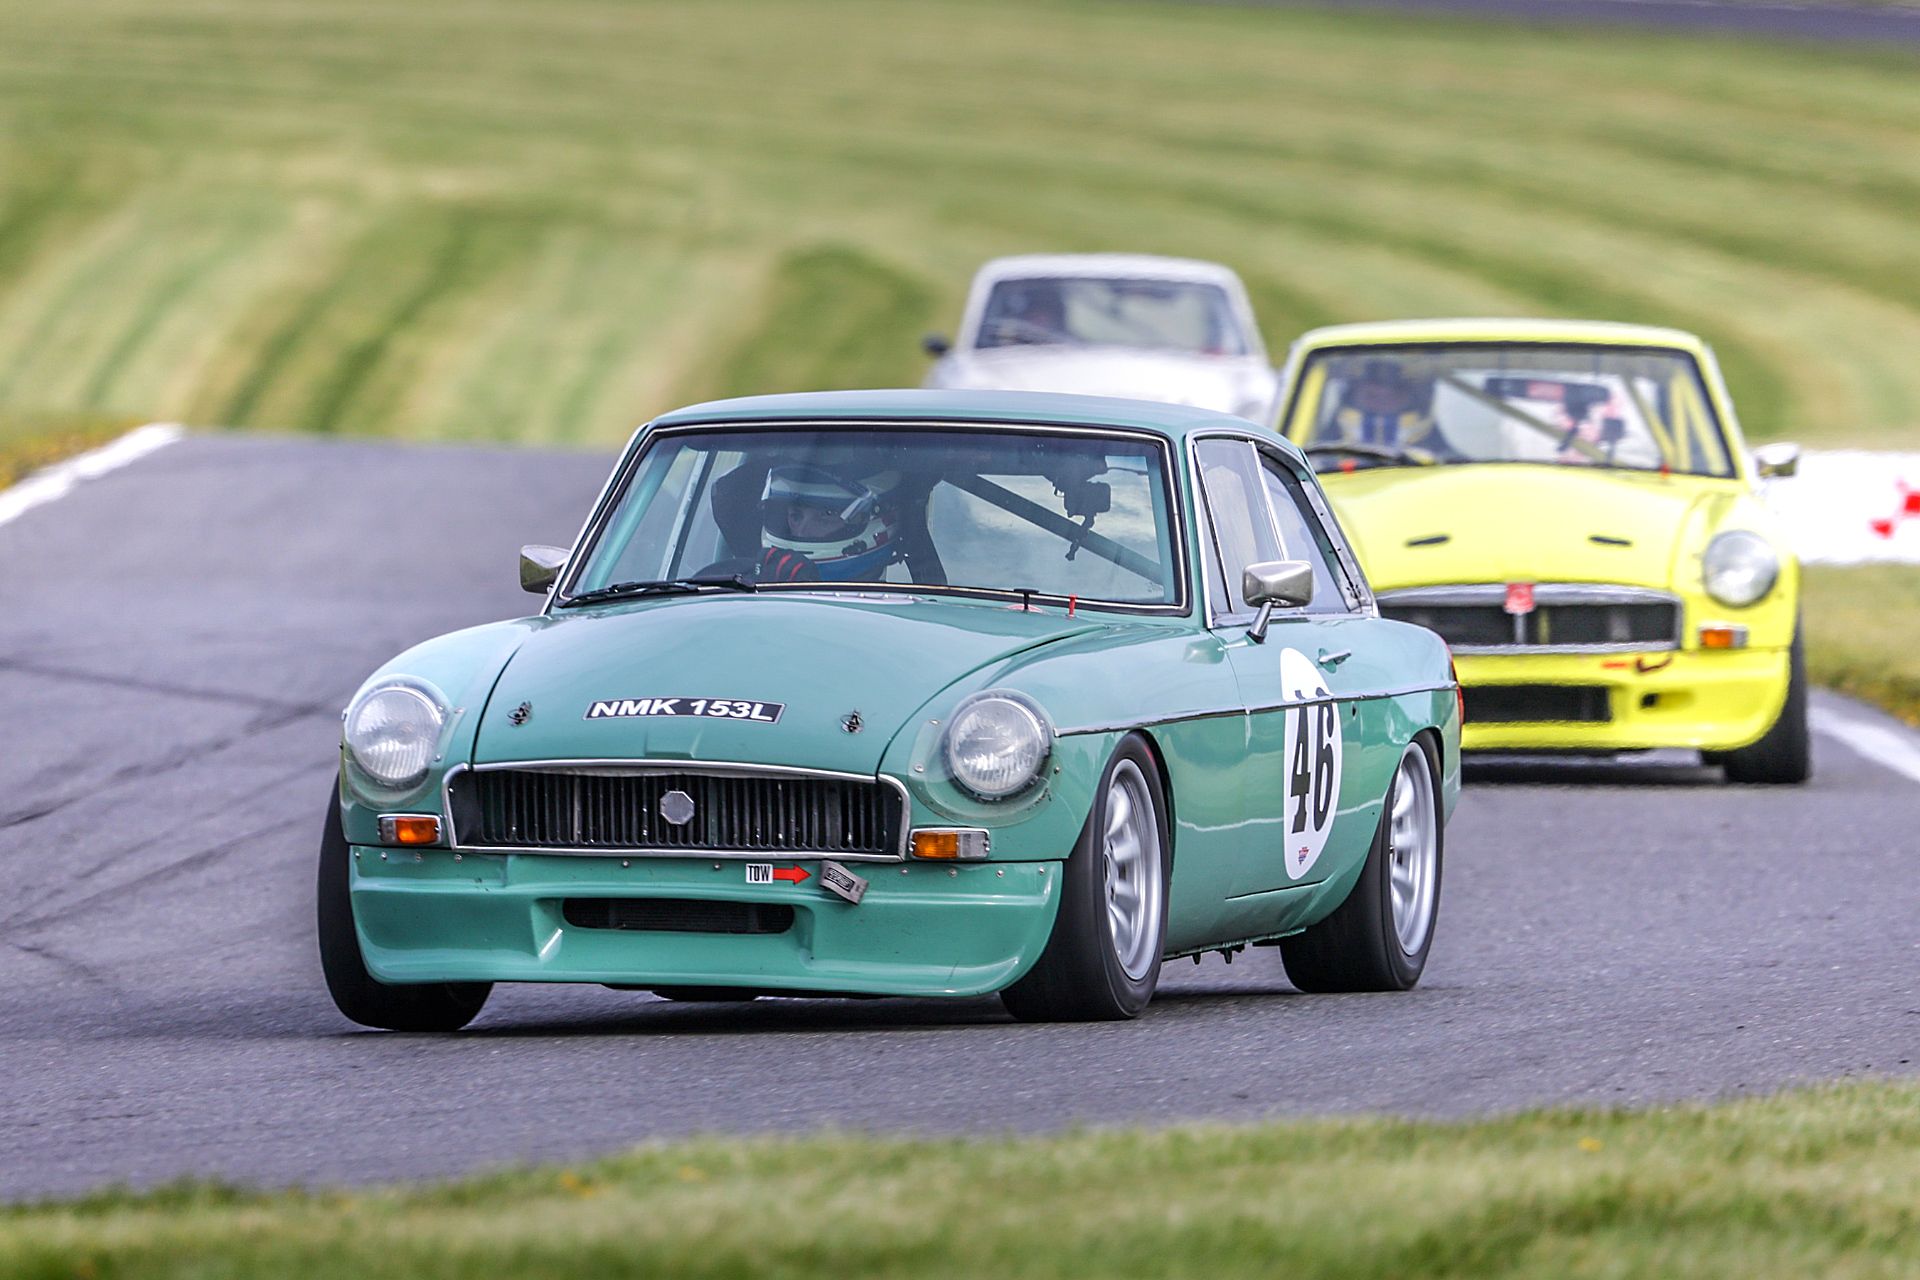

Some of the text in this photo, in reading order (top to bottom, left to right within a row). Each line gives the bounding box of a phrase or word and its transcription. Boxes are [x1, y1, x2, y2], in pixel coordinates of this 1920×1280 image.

[591, 699, 773, 720] NMK 153L
[1290, 687, 1334, 833] 46
[748, 865, 771, 881] TOW
